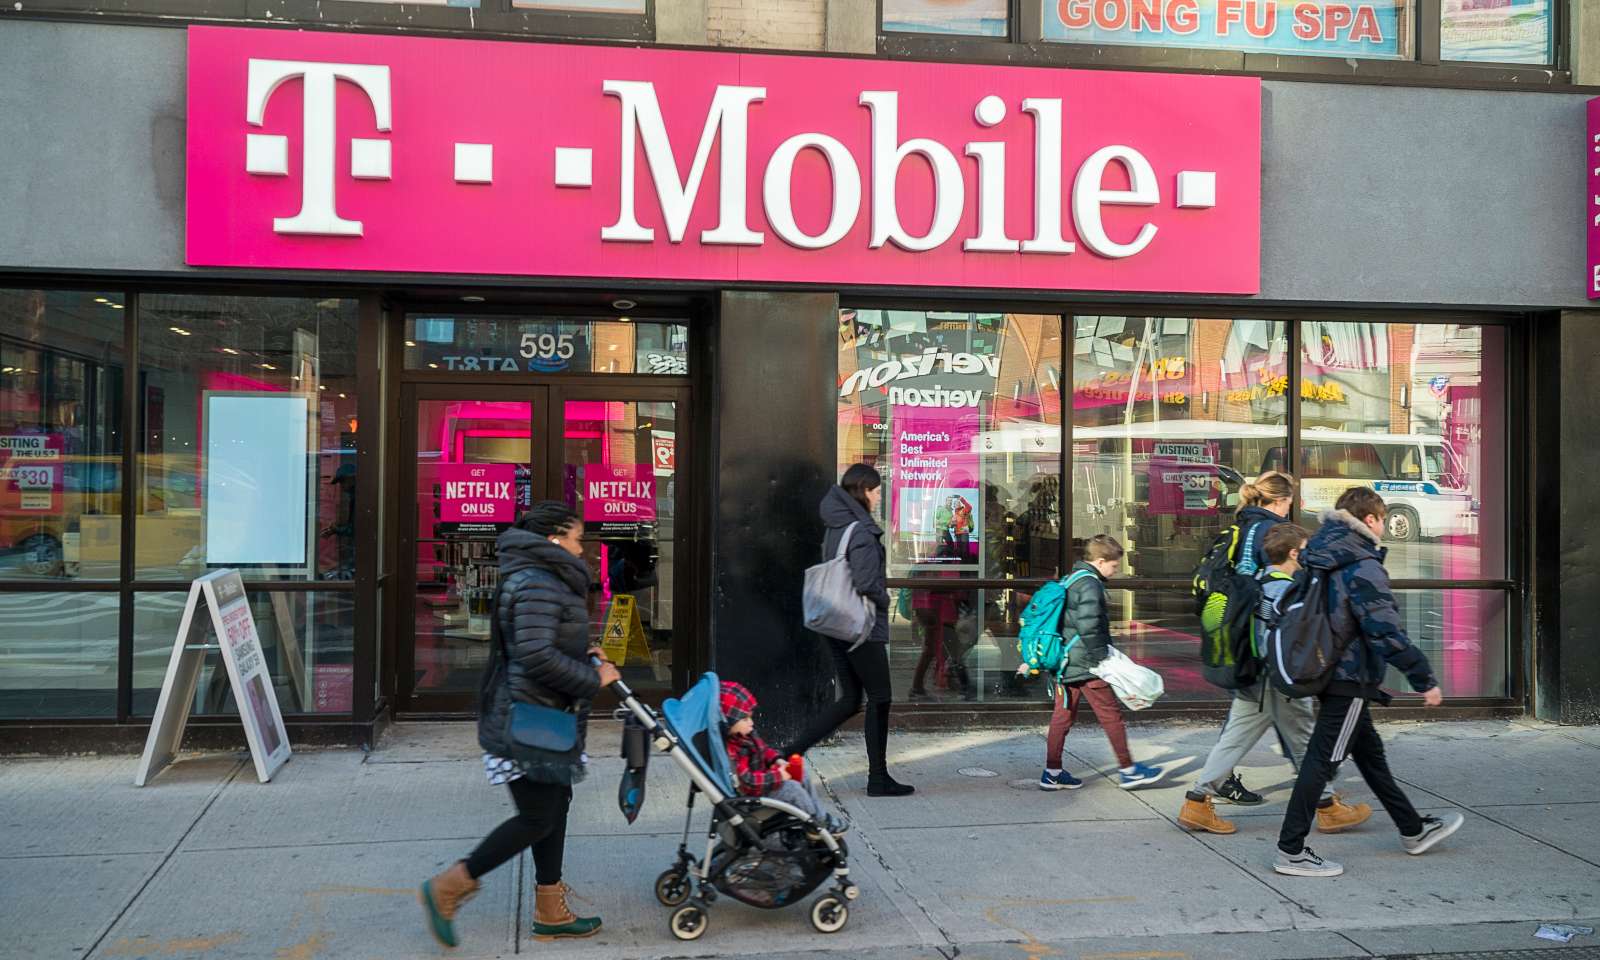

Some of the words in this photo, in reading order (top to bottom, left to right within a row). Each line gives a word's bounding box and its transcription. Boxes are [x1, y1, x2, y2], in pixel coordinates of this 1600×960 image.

[1057, 0, 1200, 33] GONG
[1215, 0, 1278, 38] FU
[1292, 4, 1384, 43] SPA
[601, 79, 1160, 259] Mobile
[519, 333, 574, 359] 595
[900, 431, 950, 442] America's
[34, 450, 55, 458] U.S.?
[900, 443, 923, 454] Best
[1159, 445, 1199, 455] VISITING
[900, 457, 948, 468] Unlimited
[21, 470, 49, 485] $30
[900, 469, 942, 481] Network
[446, 481, 510, 500] NETFLIX
[589, 481, 652, 500] NETFLIX
[461, 503, 478, 514] ON
[479, 503, 495, 514] US
[604, 502, 620, 513] ON
[621, 502, 637, 513] US
[1230, 790, 1242, 800] N
